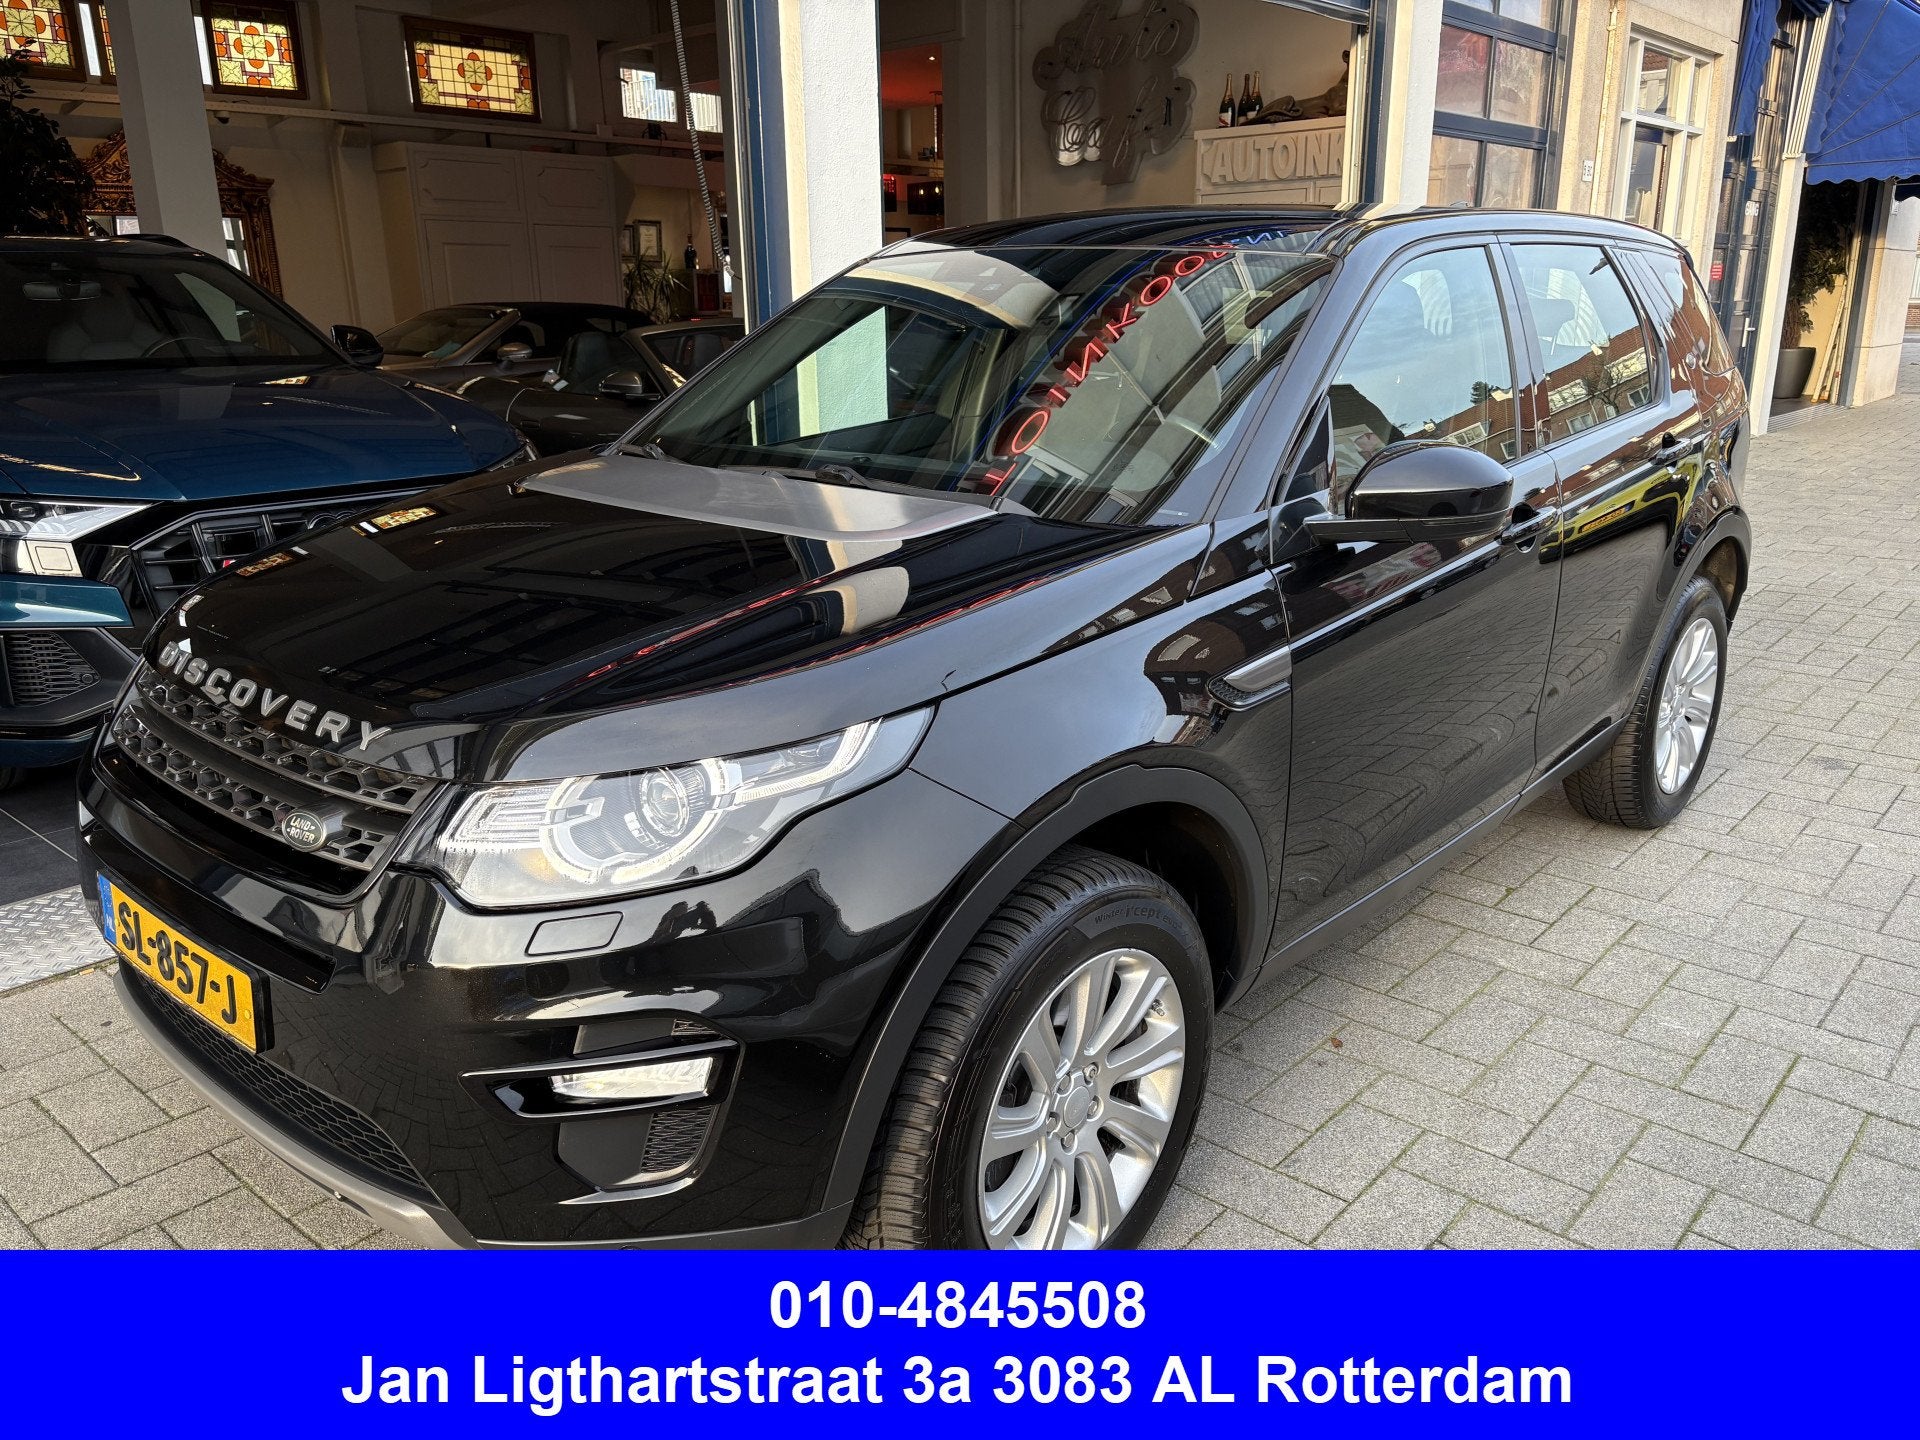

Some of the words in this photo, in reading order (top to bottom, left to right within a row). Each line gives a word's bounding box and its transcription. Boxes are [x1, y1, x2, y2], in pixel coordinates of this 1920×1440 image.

[157, 640, 393, 752] DISCOVERY
[290, 816, 311, 831] LAND
[289, 826, 315, 844] ROVER
[1094, 908, 1125, 925] Winter
[105, 912, 116, 933] NL
[118, 901, 238, 1025] SL-857-J
